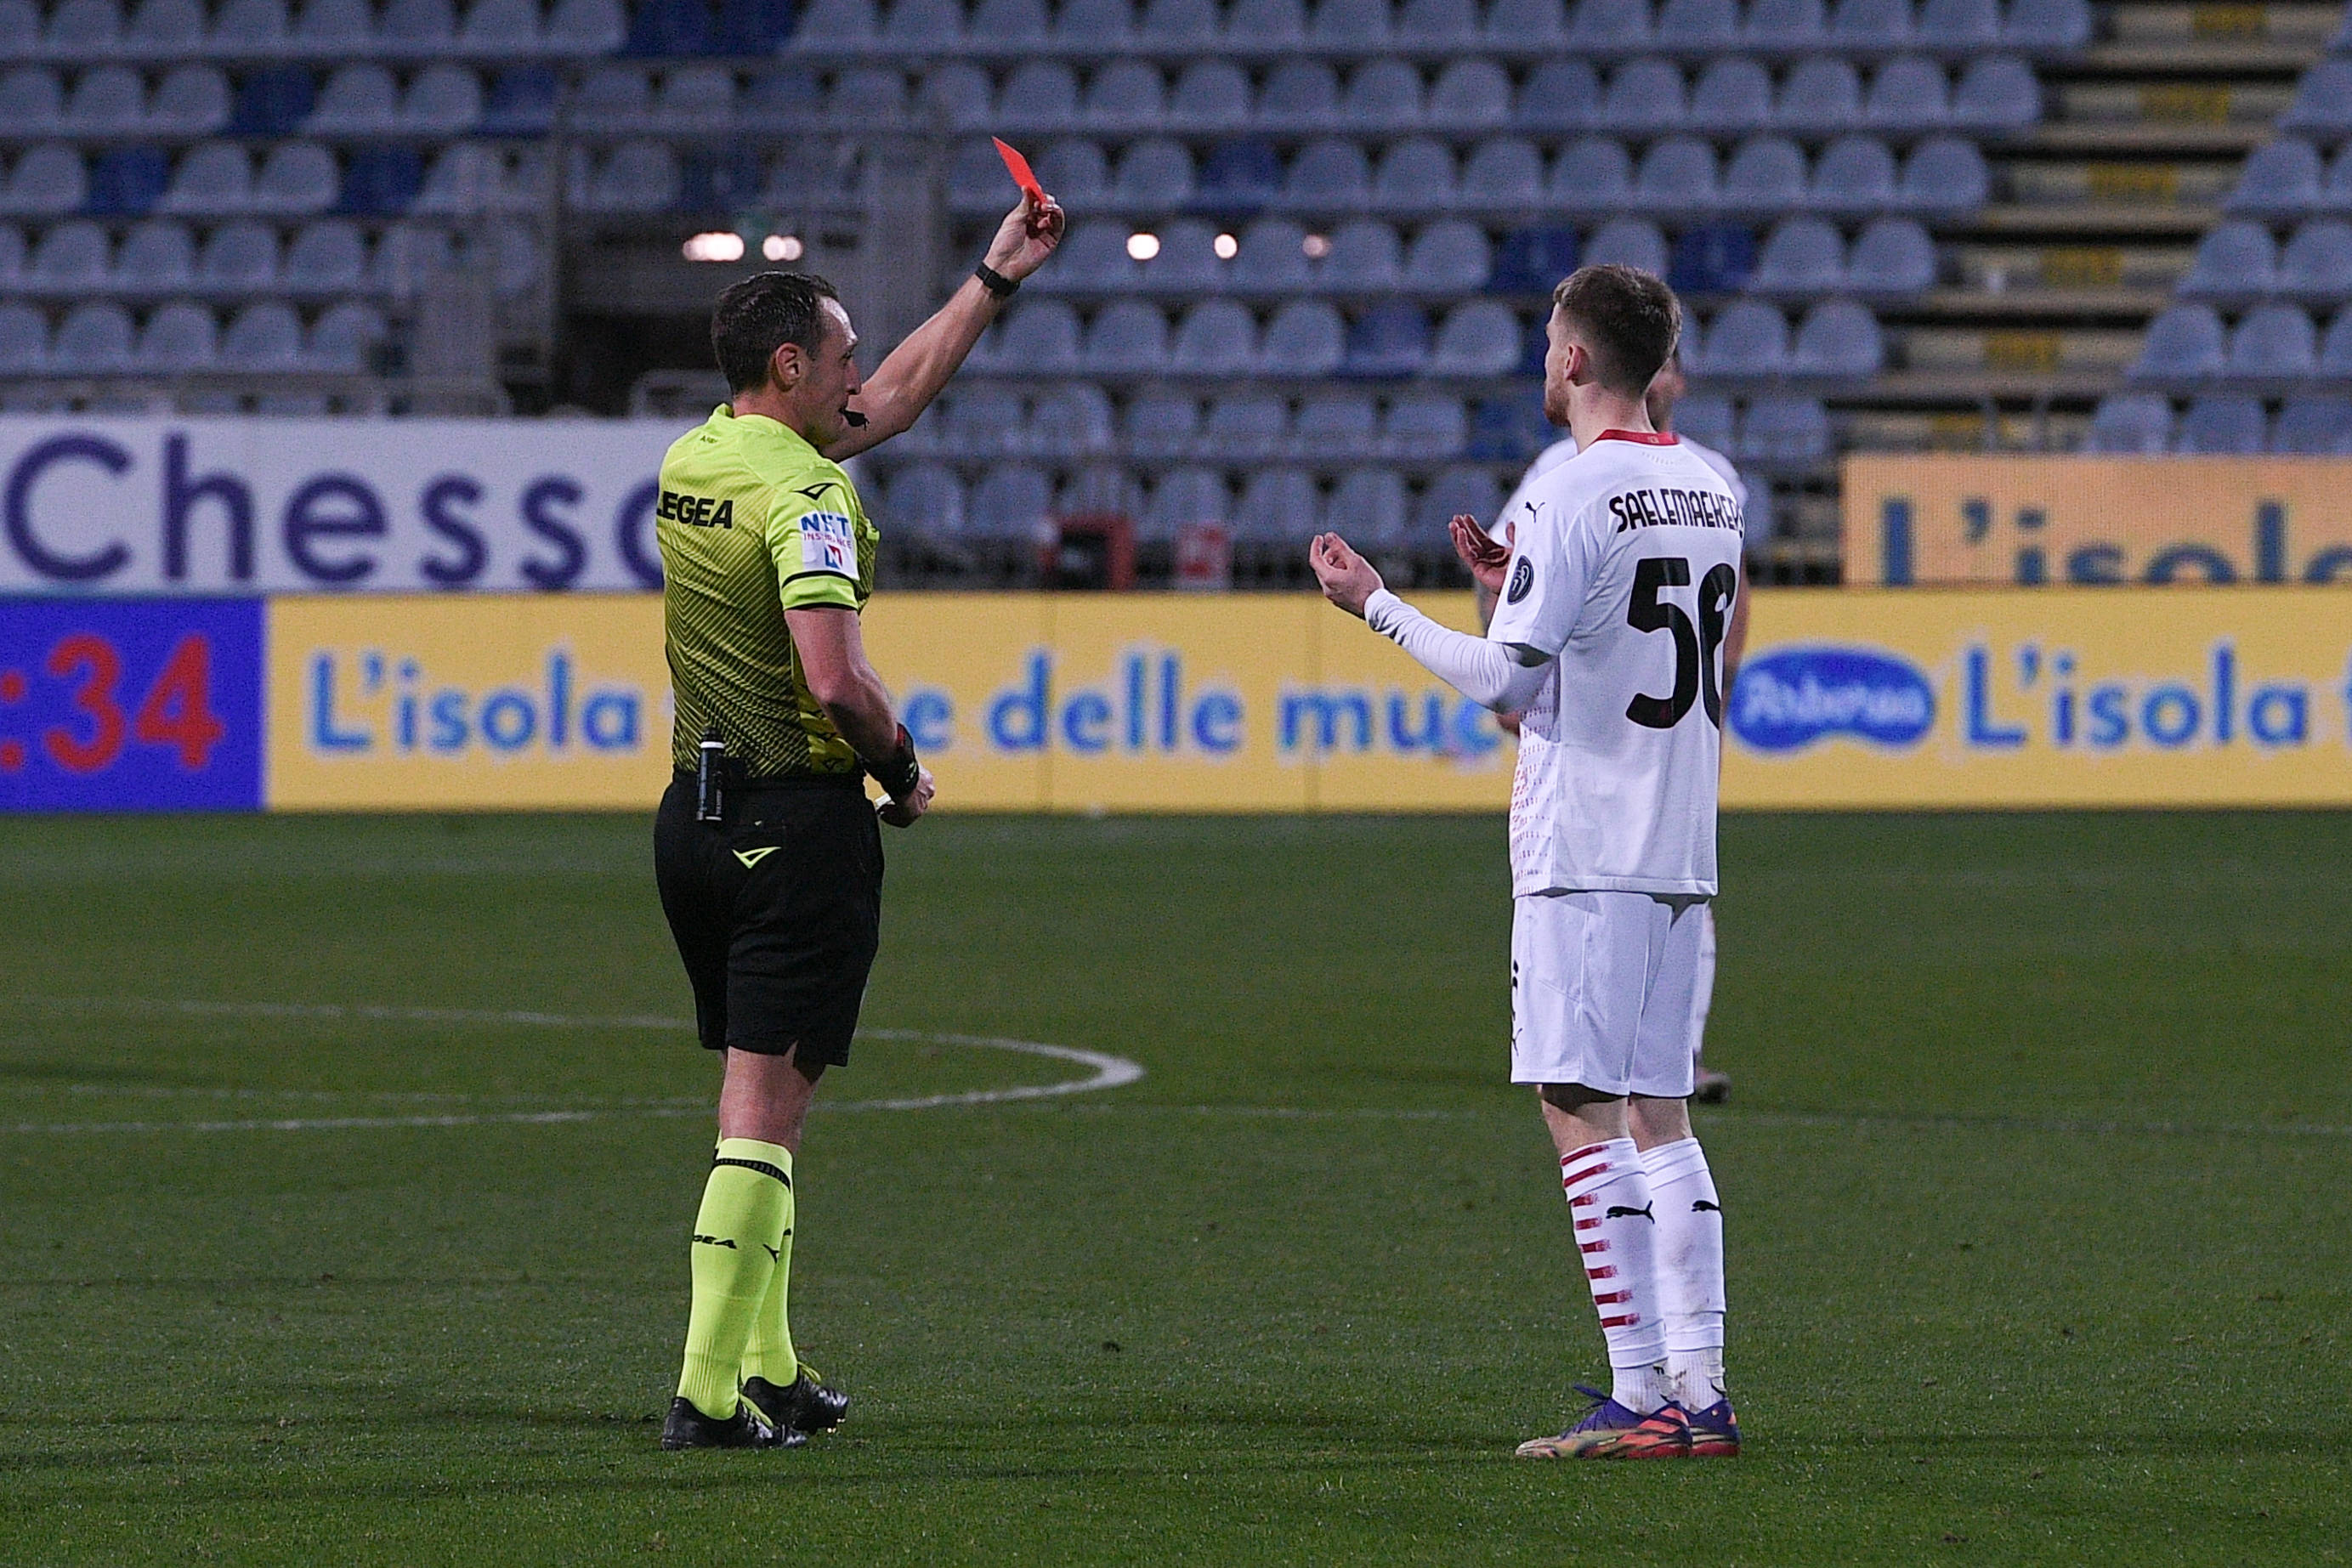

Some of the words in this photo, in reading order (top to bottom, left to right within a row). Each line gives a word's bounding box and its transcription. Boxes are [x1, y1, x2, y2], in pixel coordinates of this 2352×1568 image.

[311, 652, 639, 752] L'isola
[987, 651, 1243, 753] delle
[1281, 689, 1499, 754] muc
[1964, 643, 2307, 748] L'isola
